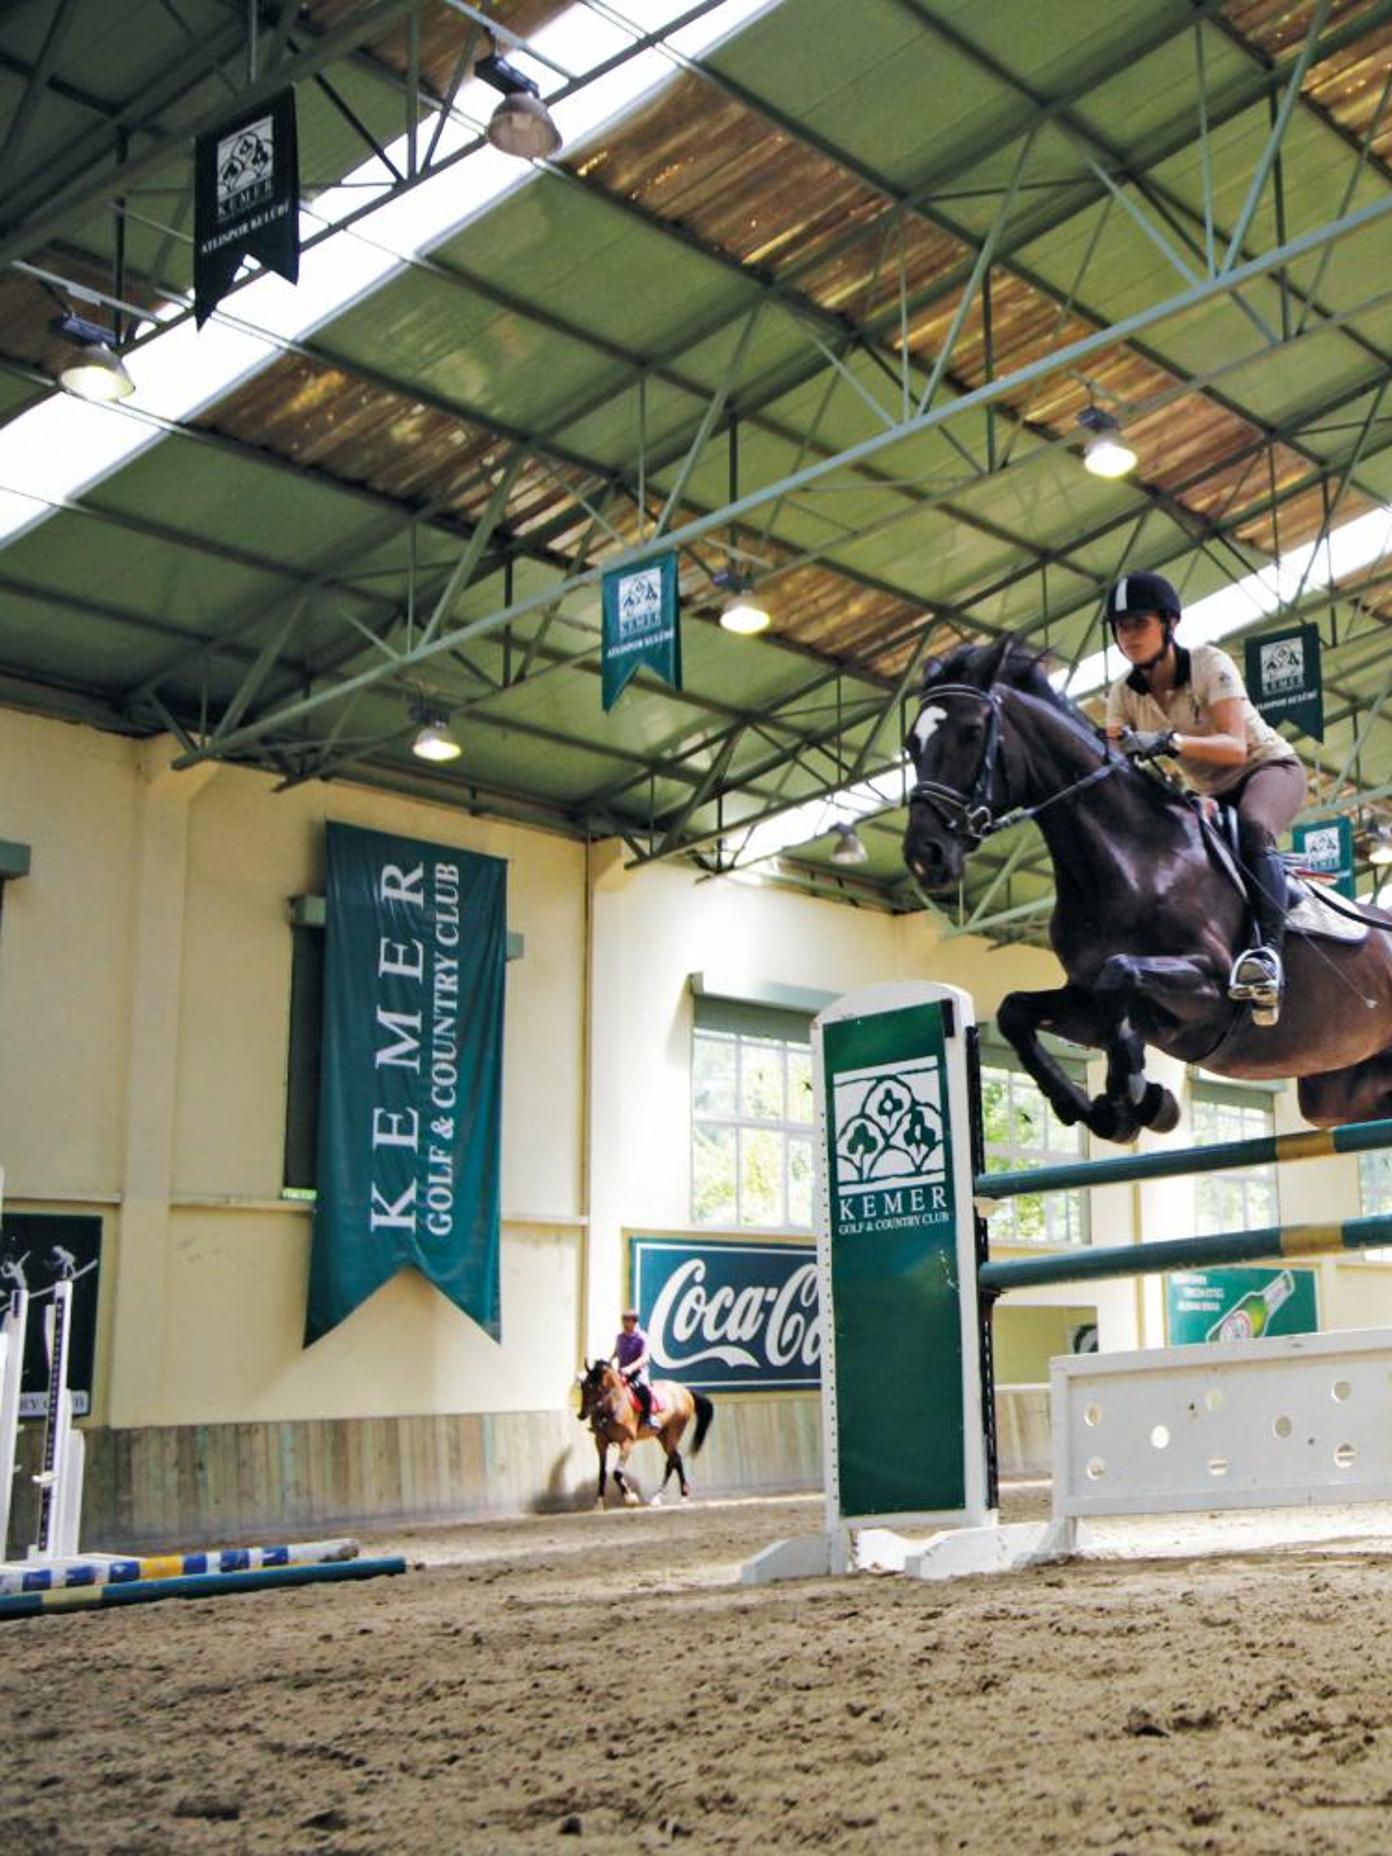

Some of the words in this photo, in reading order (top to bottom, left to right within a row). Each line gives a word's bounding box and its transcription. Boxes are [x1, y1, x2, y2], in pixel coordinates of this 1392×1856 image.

[434, 862, 461, 947] CLUB
[370, 861, 425, 1233] KEMER
[431, 952, 460, 1109] COUNTRY
[431, 1116, 456, 1140] &
[427, 1144, 455, 1237] GOLF
[839, 1185, 948, 1221] KEMER
[839, 1222, 864, 1235] GOLF
[876, 1213, 921, 1230] COUNTRY
[922, 1211, 949, 1224] CLUB
